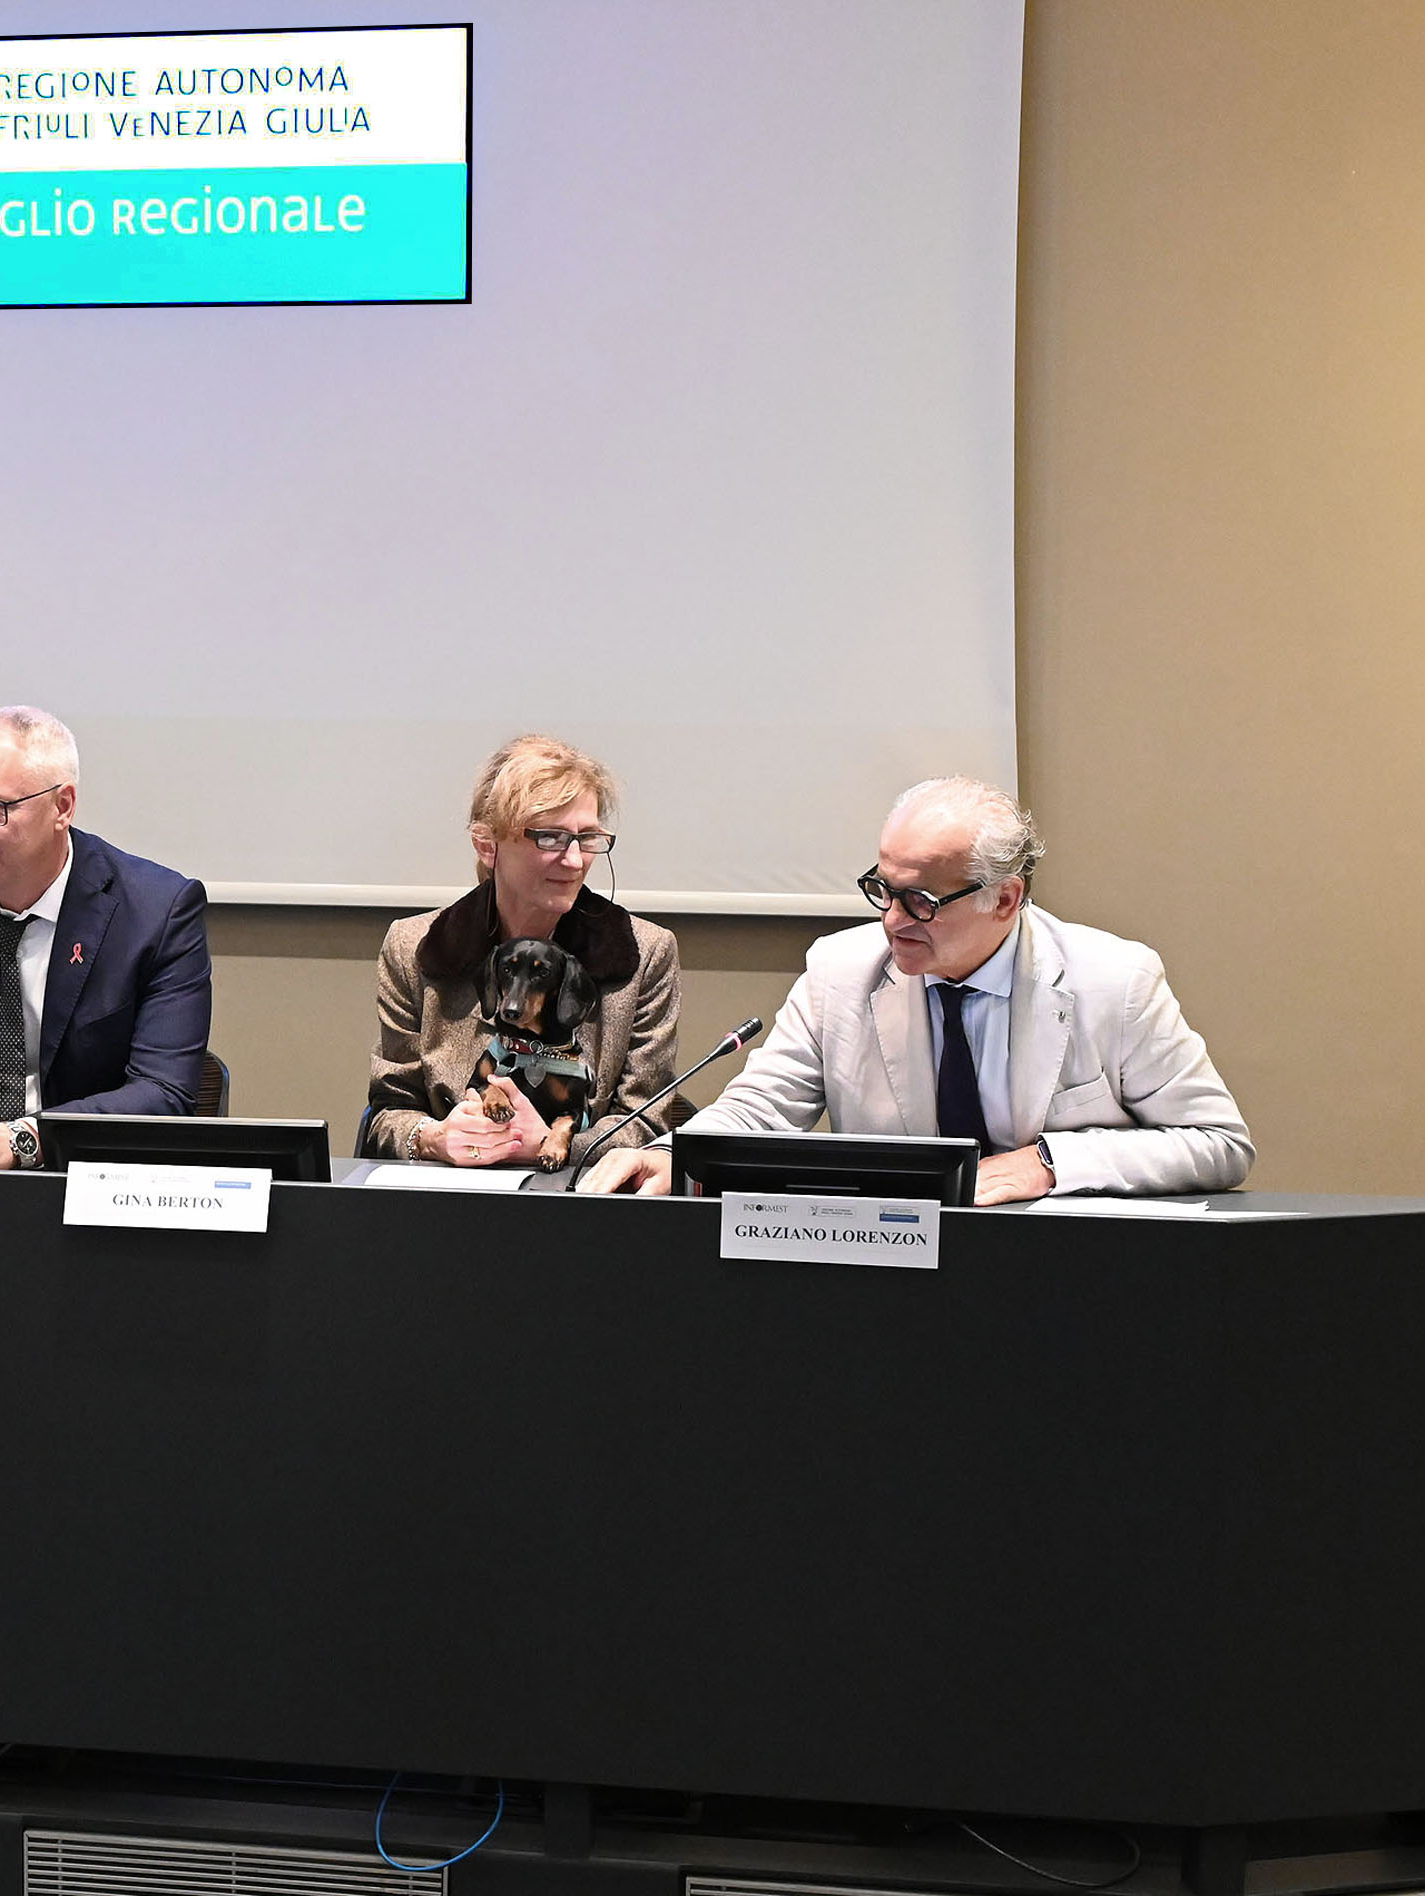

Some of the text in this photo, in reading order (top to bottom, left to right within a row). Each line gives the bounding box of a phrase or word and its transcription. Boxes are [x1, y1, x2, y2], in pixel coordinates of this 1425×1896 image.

[154, 65, 350, 98] AUTONOMA
[110, 109, 247, 138] VENEZIA
[266, 105, 371, 134] GIULIA
[112, 1194, 224, 1209] GINA BERTON
[735, 1224, 928, 1246] GRAZIANO LORENZON
